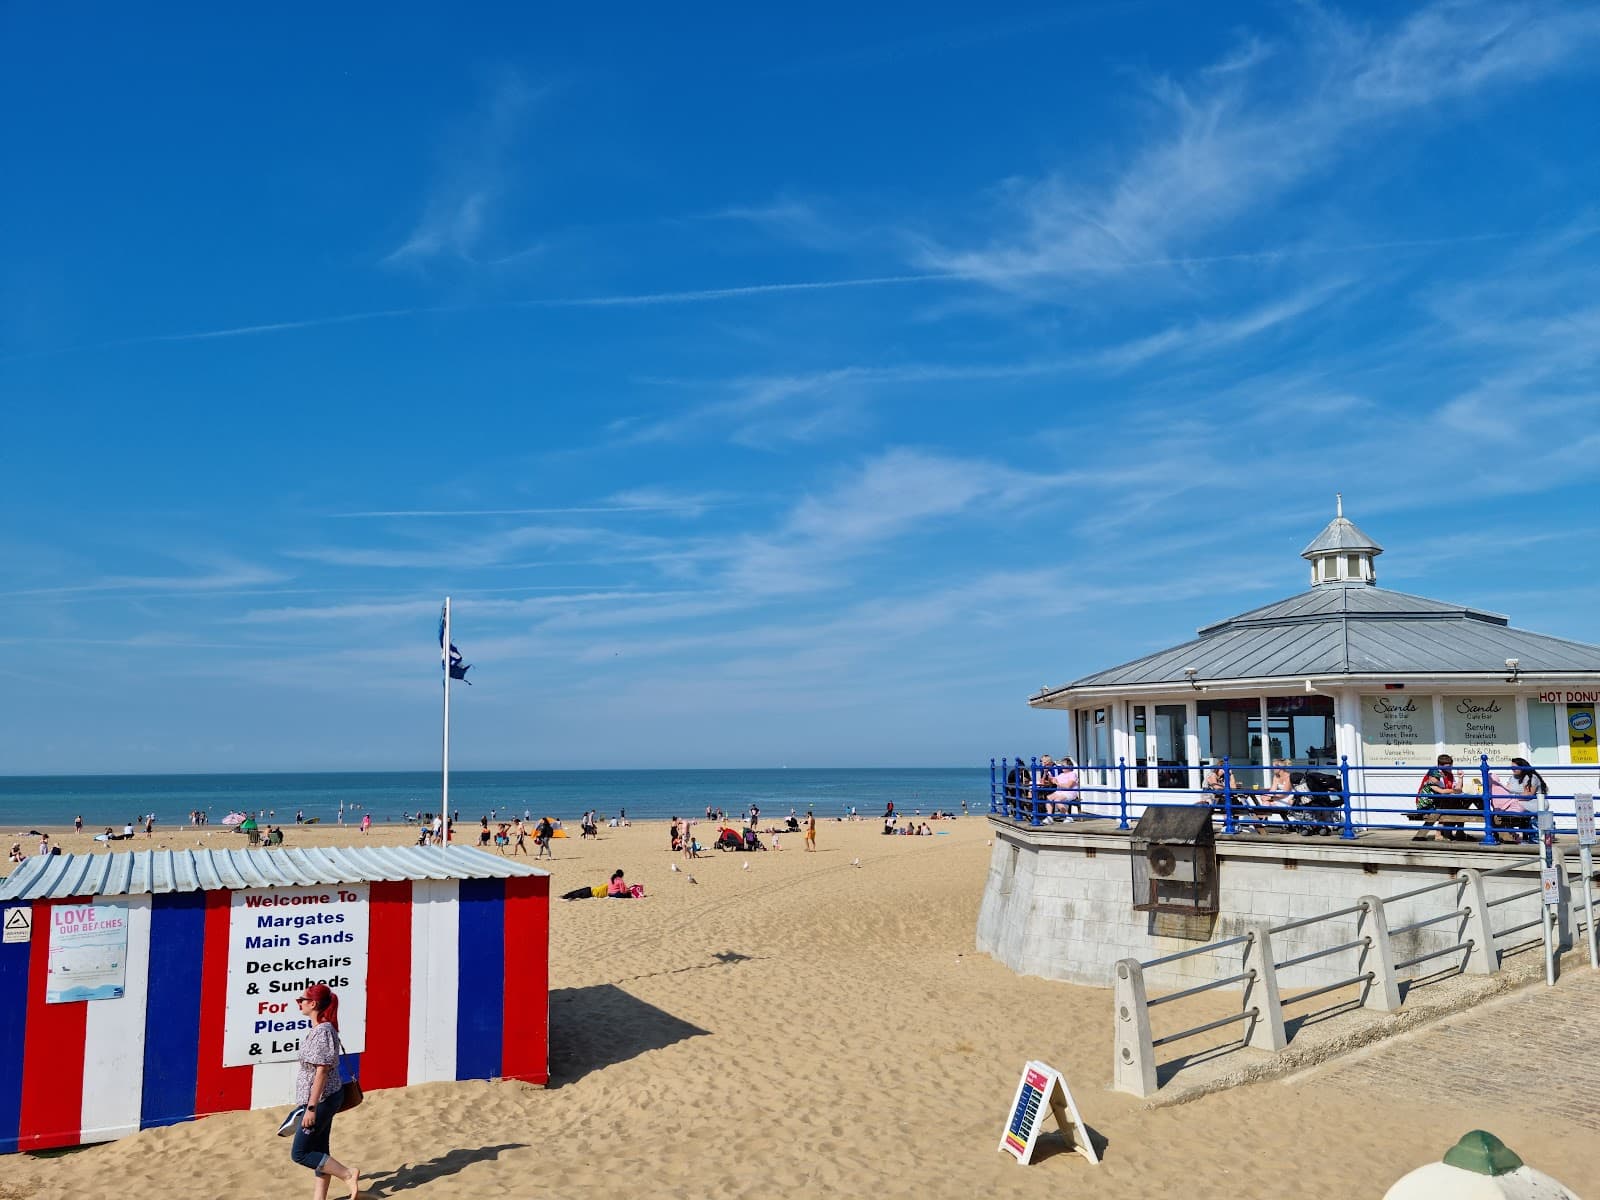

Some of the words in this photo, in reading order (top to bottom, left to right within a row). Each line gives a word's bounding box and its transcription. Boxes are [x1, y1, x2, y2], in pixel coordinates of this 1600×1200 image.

[1373, 697, 1418, 713] Sands
[1540, 691, 1562, 702] HOT
[1456, 698, 1502, 713] Sands
[1383, 722, 1413, 733] Serving
[1466, 722, 1495, 733] Serving
[1484, 748, 1501, 756] Chips
[245, 893, 331, 908] Welcome
[338, 890, 357, 903] To
[55, 908, 96, 926] LOVE
[257, 912, 345, 929] Margates
[60, 924, 79, 935] OUR
[82, 918, 123, 932] BEACHES
[245, 934, 291, 950] Main
[298, 930, 354, 946] Sands
[246, 954, 352, 974] Deckchairs
[246, 982, 260, 996] &
[269, 975, 349, 993] Sunbeds
[258, 1001, 288, 1015] For
[248, 1042, 262, 1056] &
[271, 1038, 299, 1054] Lei
